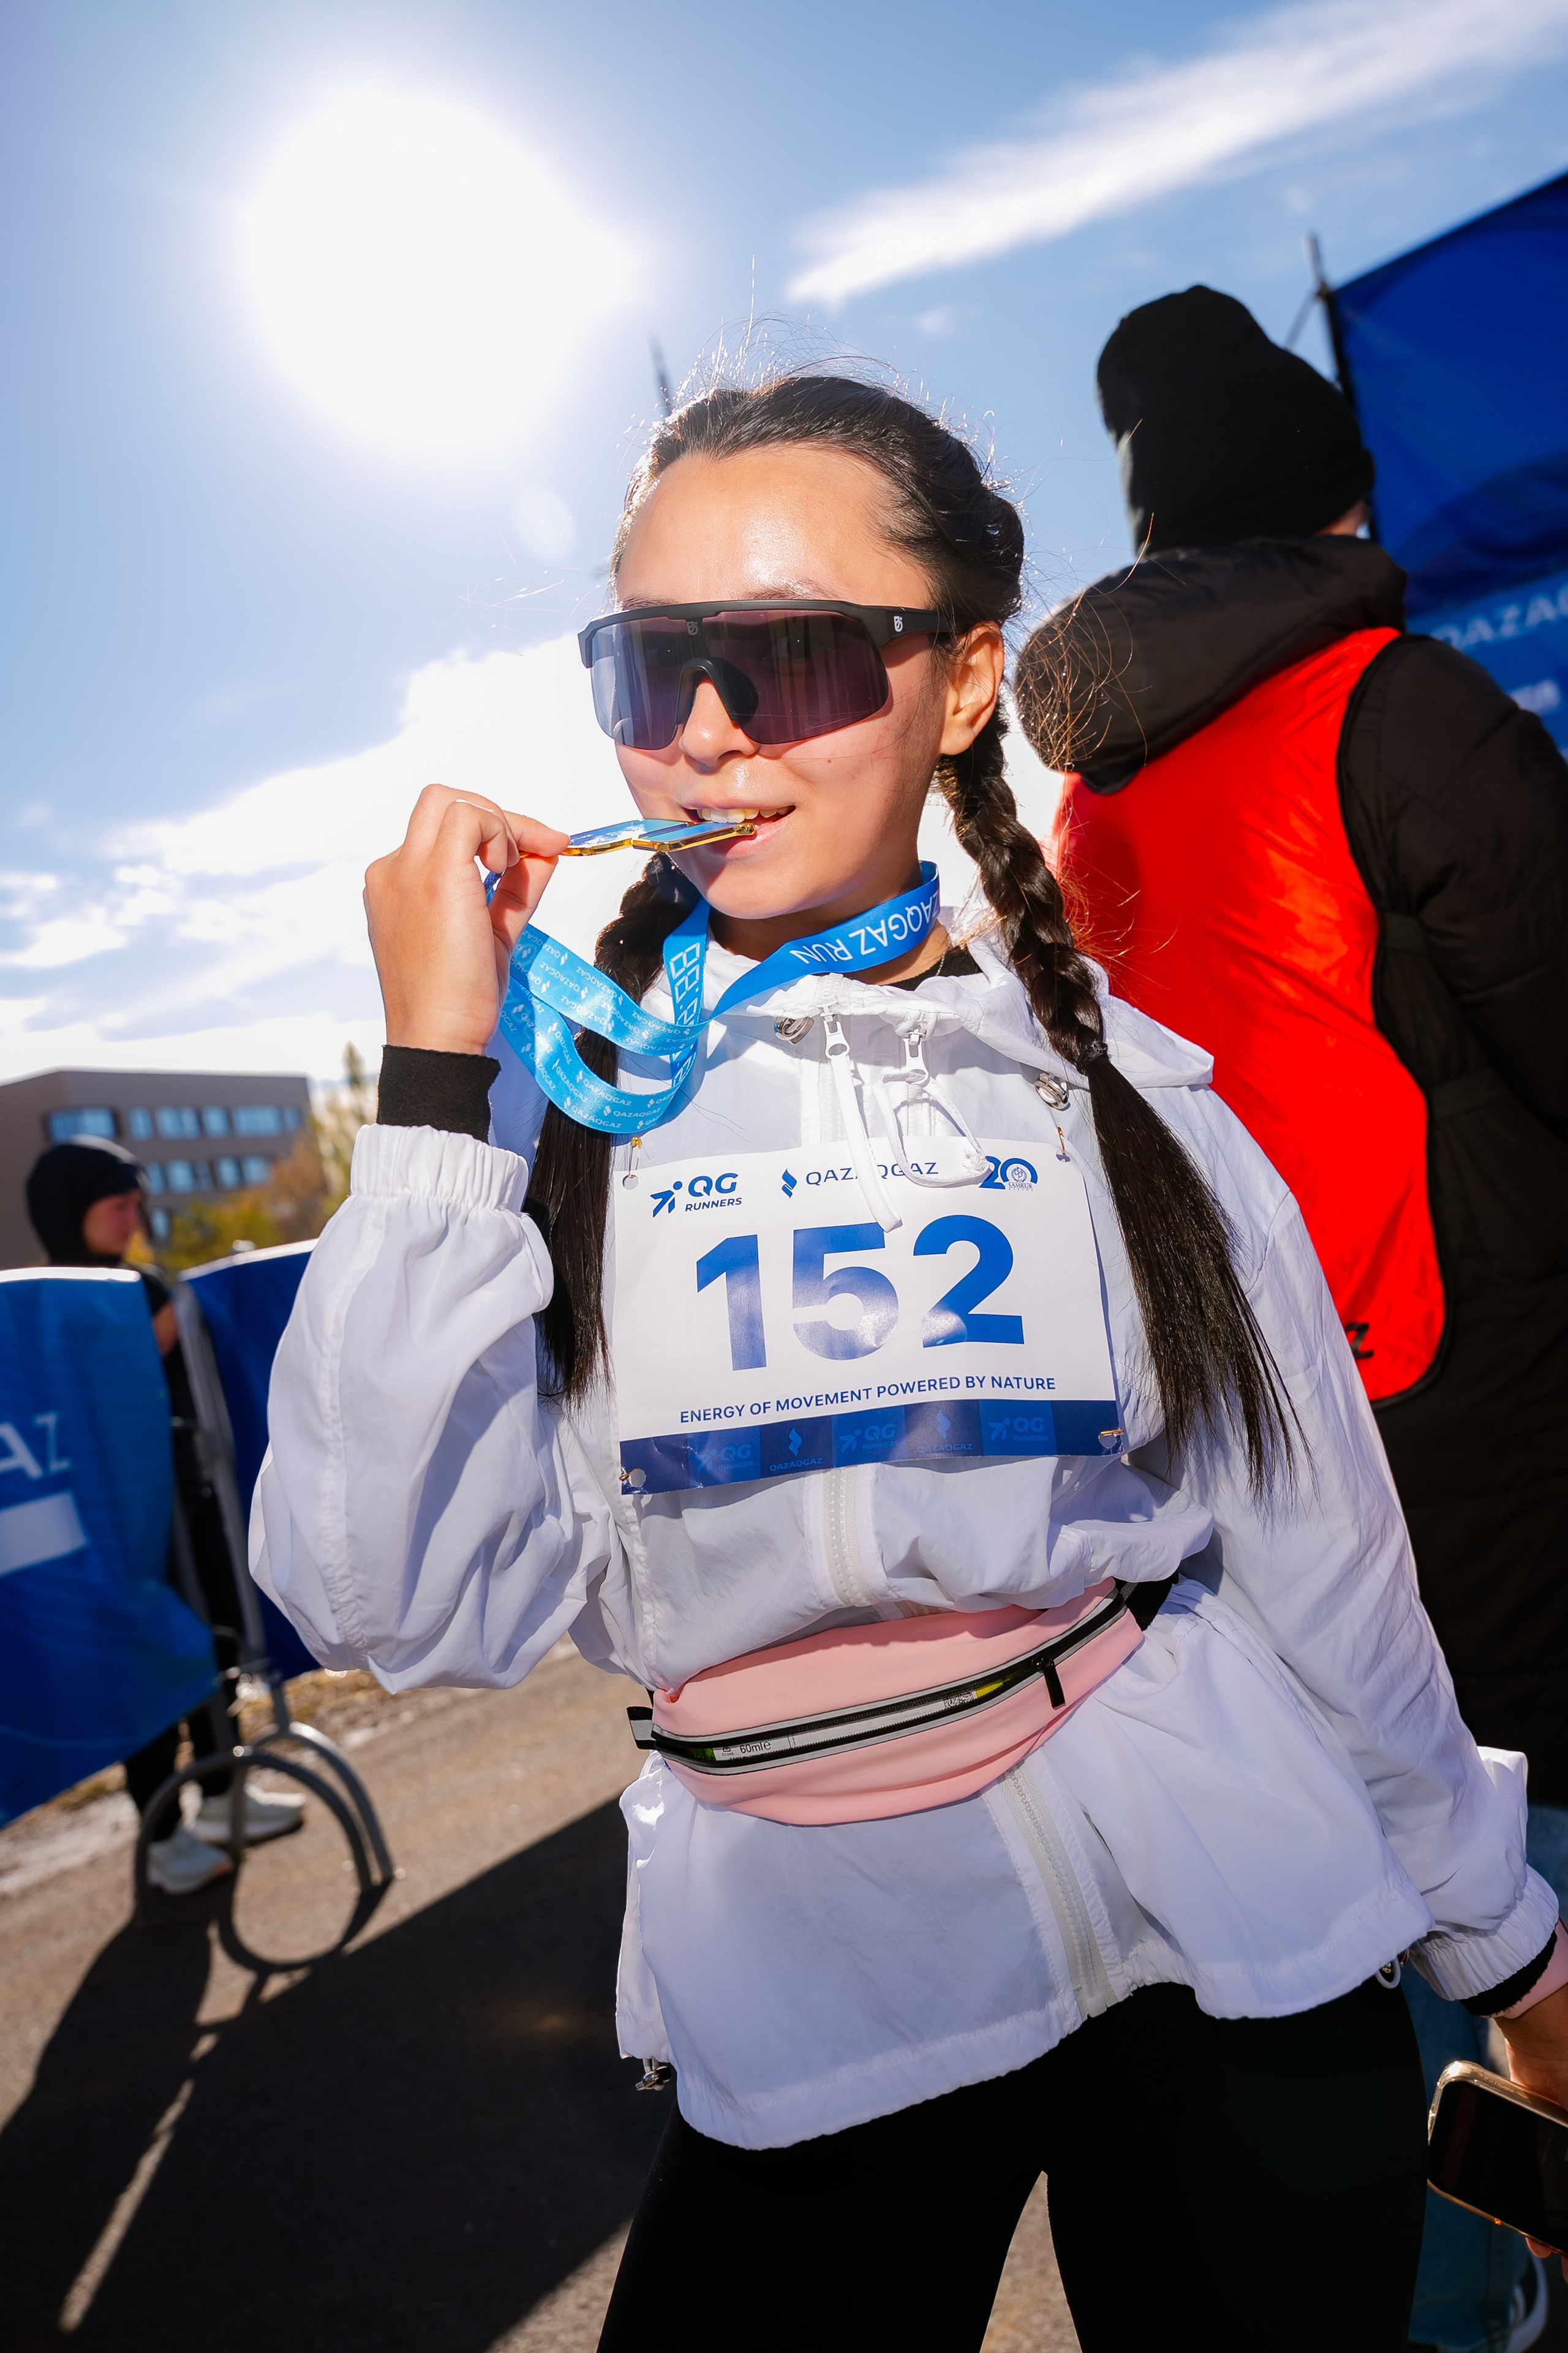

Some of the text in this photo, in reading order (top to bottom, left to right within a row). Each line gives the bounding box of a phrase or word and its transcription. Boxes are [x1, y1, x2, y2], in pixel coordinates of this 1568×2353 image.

[790, 939, 854, 964] RUN
[539, 962, 580, 992] QAZAQGAZ
[576, 966, 617, 999] QAZAQGAZ
[529, 1052, 556, 1092] QAZAQGAZ
[556, 1066, 589, 1103] QAZAQGAZ
[583, 1079, 632, 1106] QAZAQGAZ
[571, 1104, 622, 1128] QAZAQGAZ
[612, 1106, 662, 1118] QAZAQGAZ
[805, 1162, 939, 1186] QAZQGAZ
[979, 1155, 1038, 1190] 20
[688, 1173, 739, 1197] QG
[685, 1197, 742, 1212] RUNNERS
[696, 1214, 1025, 1371] 152
[680, 1376, 1056, 1423] ENERGY OF MOVEMENT POWERED BY NATURE
[864, 1422, 897, 1441] QG
[1012, 1416, 1045, 1433] QG
[720, 1443, 752, 1461] QG
[862, 1440, 900, 1451] RUNNERS
[917, 1443, 974, 1454] QAZAQGAZ
[769, 1456, 823, 1471] QAZAQGAZ
